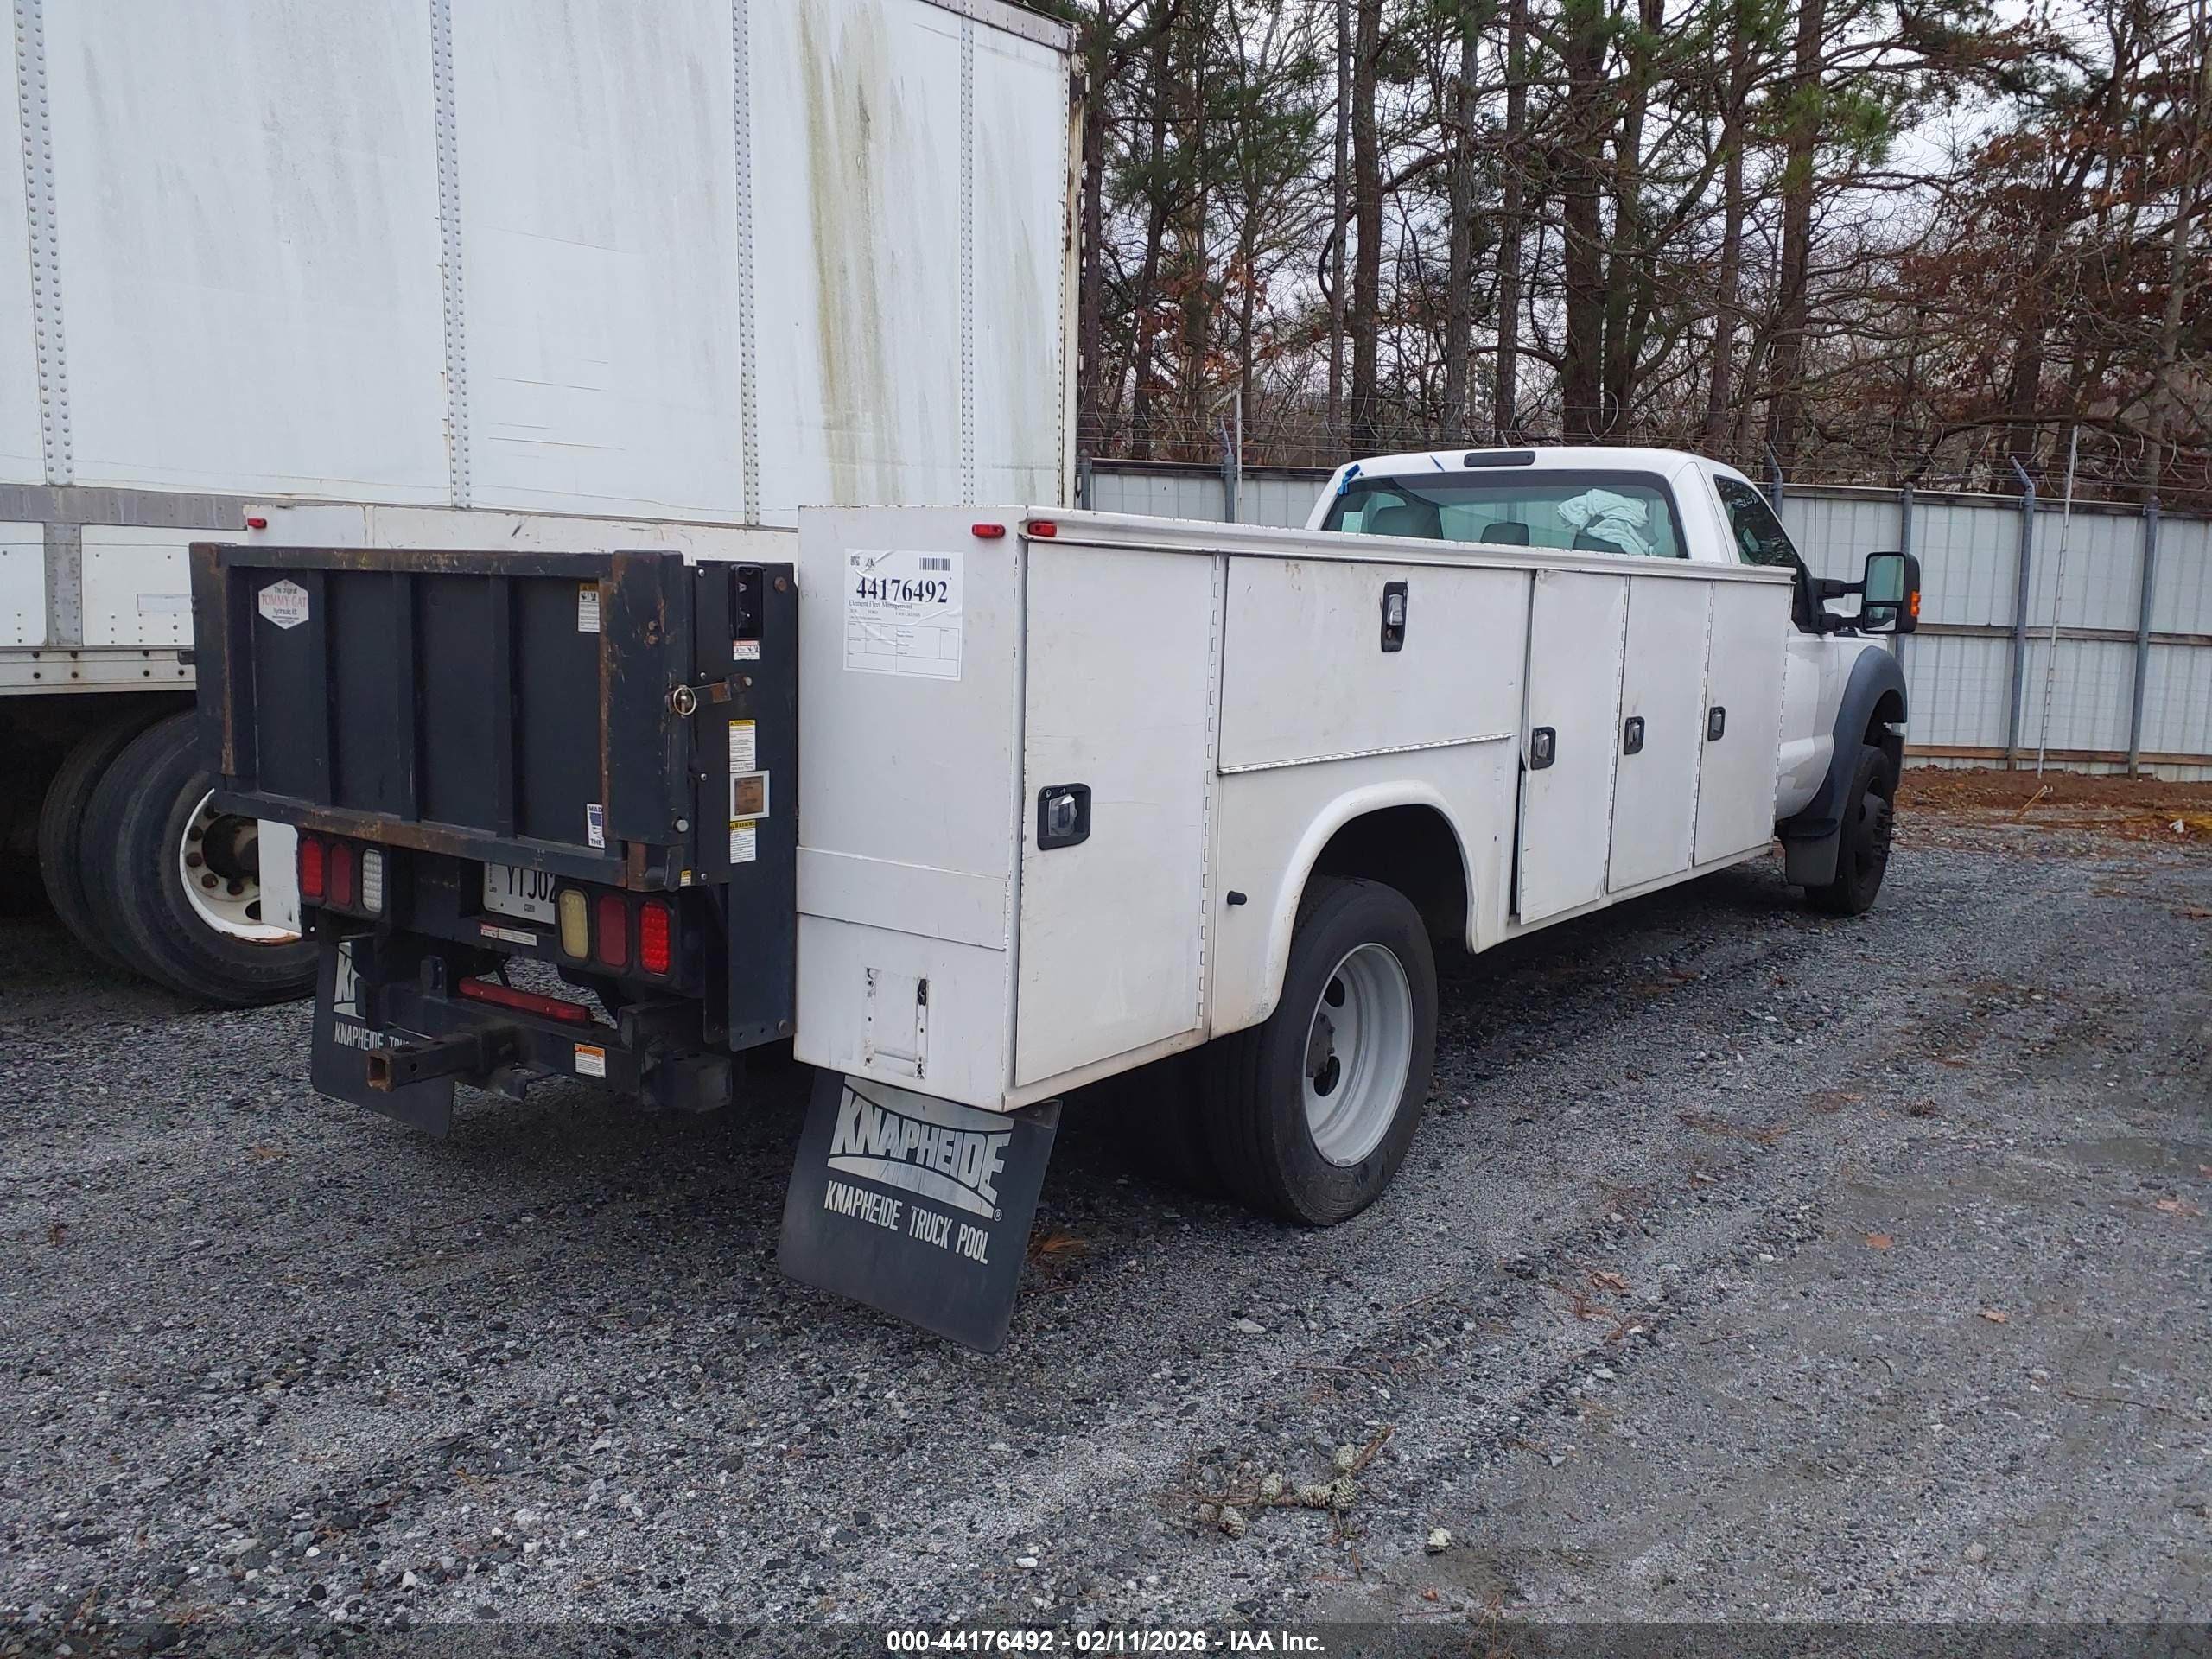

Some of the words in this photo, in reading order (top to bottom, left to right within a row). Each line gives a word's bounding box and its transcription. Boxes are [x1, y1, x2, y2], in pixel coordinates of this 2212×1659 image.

[261, 594, 289, 607] TOMMY
[291, 596, 306, 608] GAT
[855, 576, 948, 603] 44176492
[882, 601, 912, 610] Management
[334, 1021, 384, 1052] KNAPHEIDE
[830, 1086, 1012, 1205] KNAPHEIDE
[823, 1180, 903, 1231] KNAPHEIDE
[908, 1206, 953, 1249] TRUCK
[956, 1223, 988, 1265] POOL
